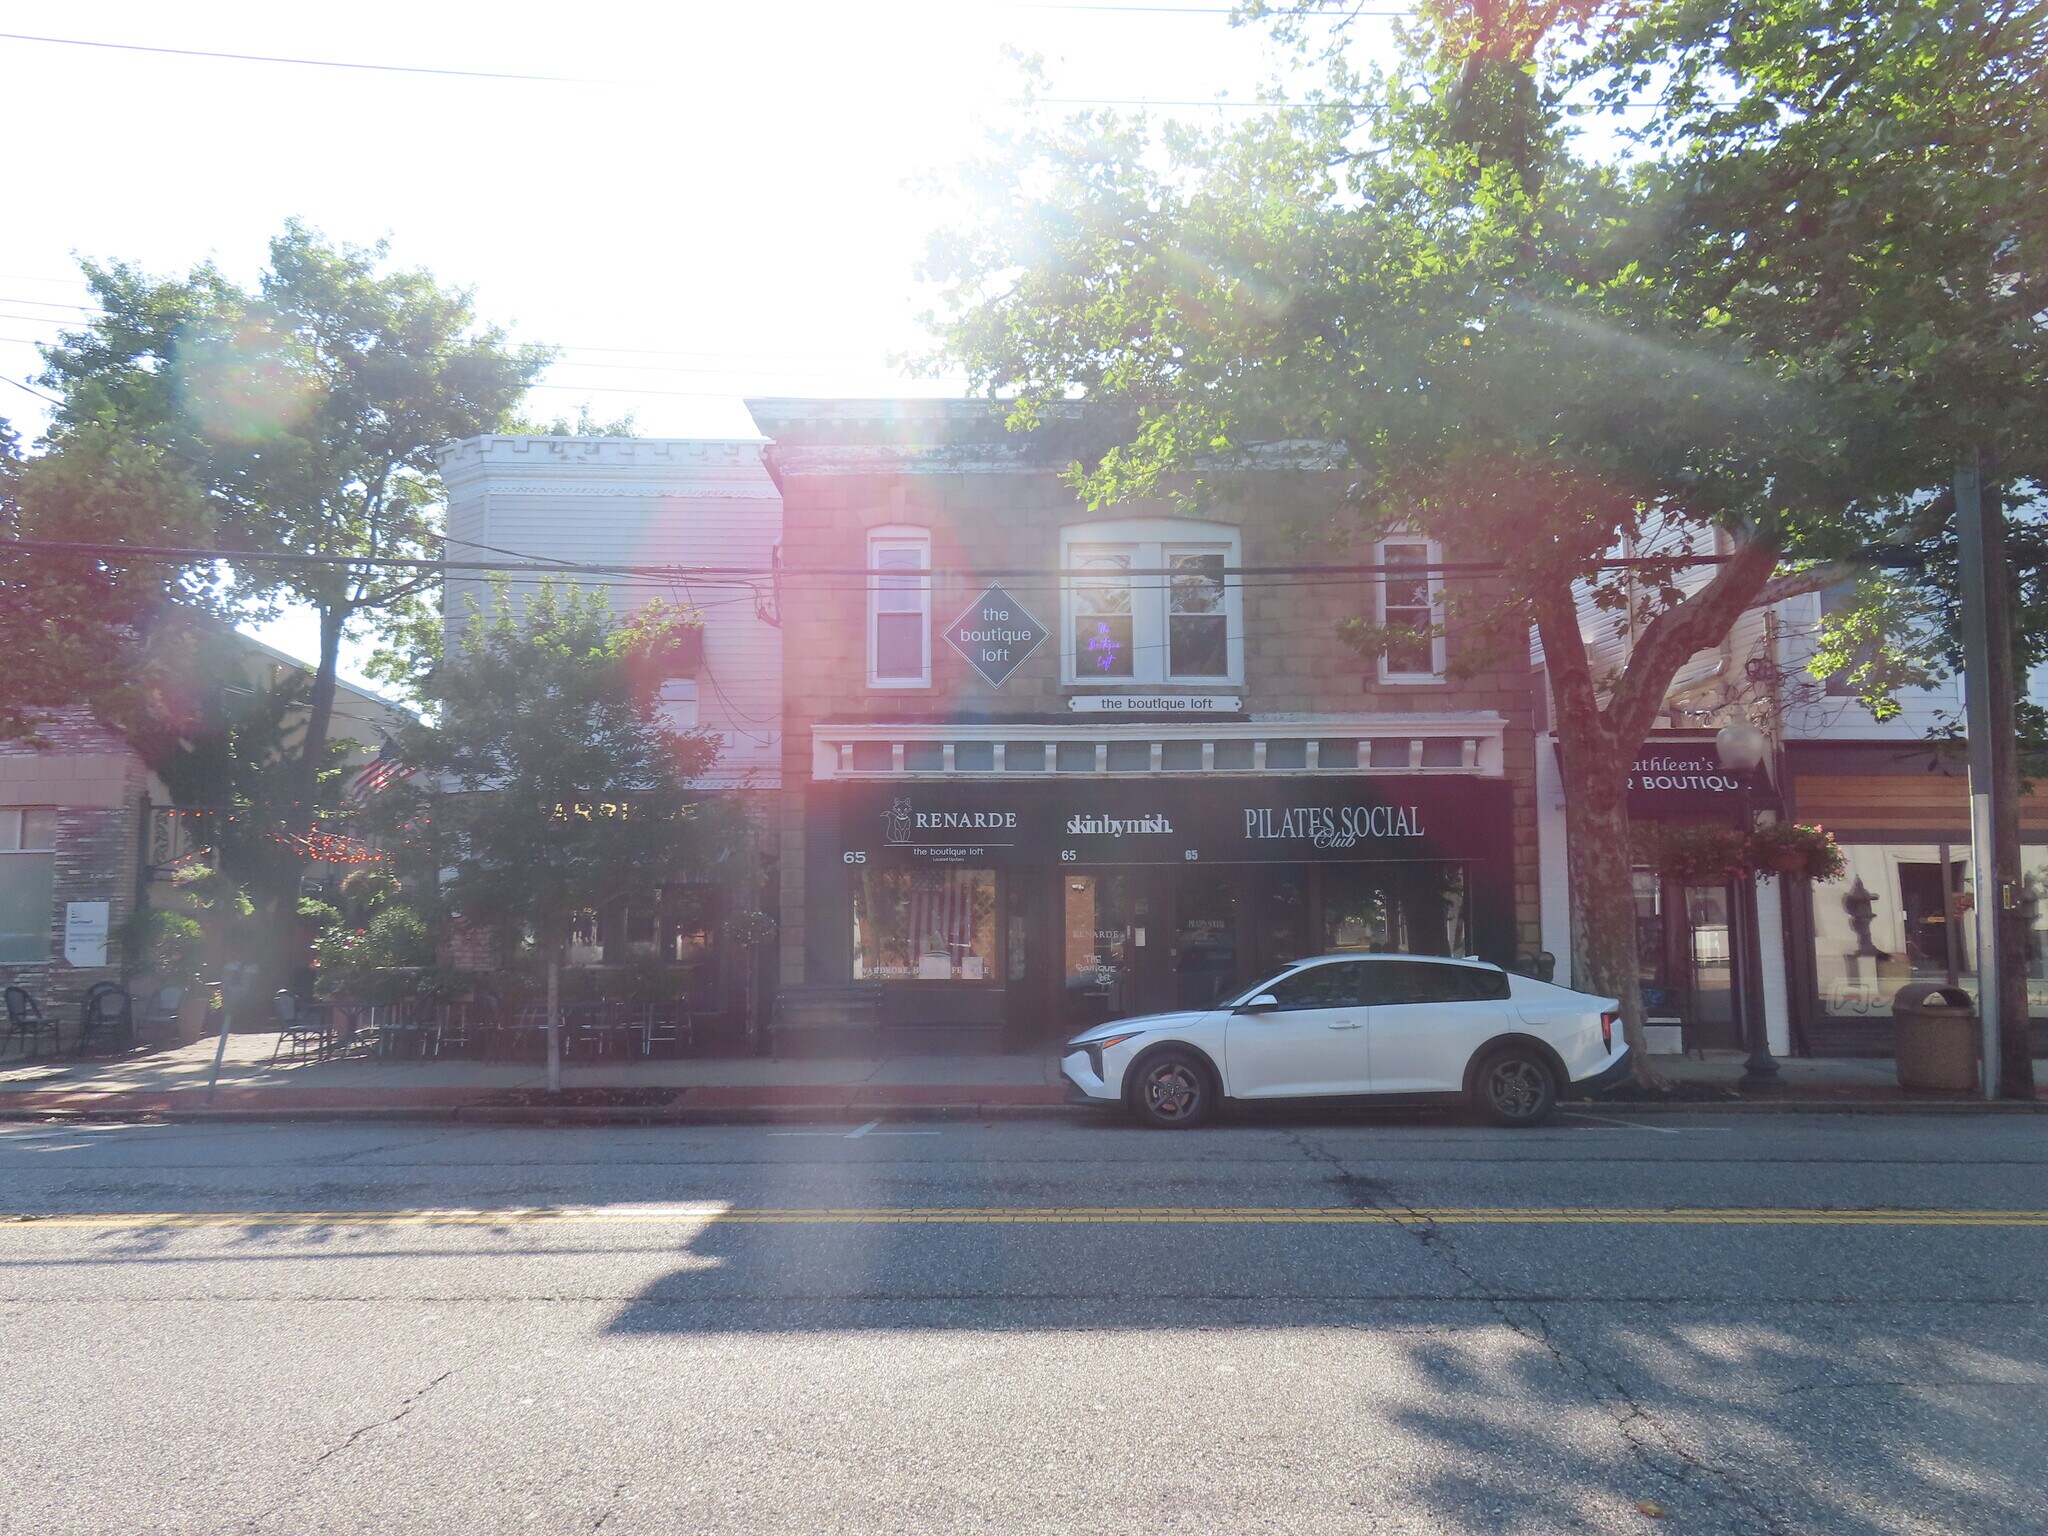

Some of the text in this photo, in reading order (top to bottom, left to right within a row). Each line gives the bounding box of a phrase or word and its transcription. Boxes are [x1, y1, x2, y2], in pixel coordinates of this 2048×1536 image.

[983, 608, 1009, 621] the
[960, 628, 1031, 645] boutique
[982, 649, 1010, 662] loft
[1101, 698, 1213, 712] the boutique loft
[1632, 757, 1714, 772] athleen's
[1642, 776, 1752, 791] BOUTIQU
[916, 813, 1017, 828] RENARDE
[1244, 806, 1425, 839] PILATES SOCIAL
[1308, 826, 1356, 849] Club
[843, 851, 867, 864] 65
[913, 848, 984, 857] the boutique loft
[1061, 850, 1076, 861] 65
[1185, 850, 1198, 861] 65
